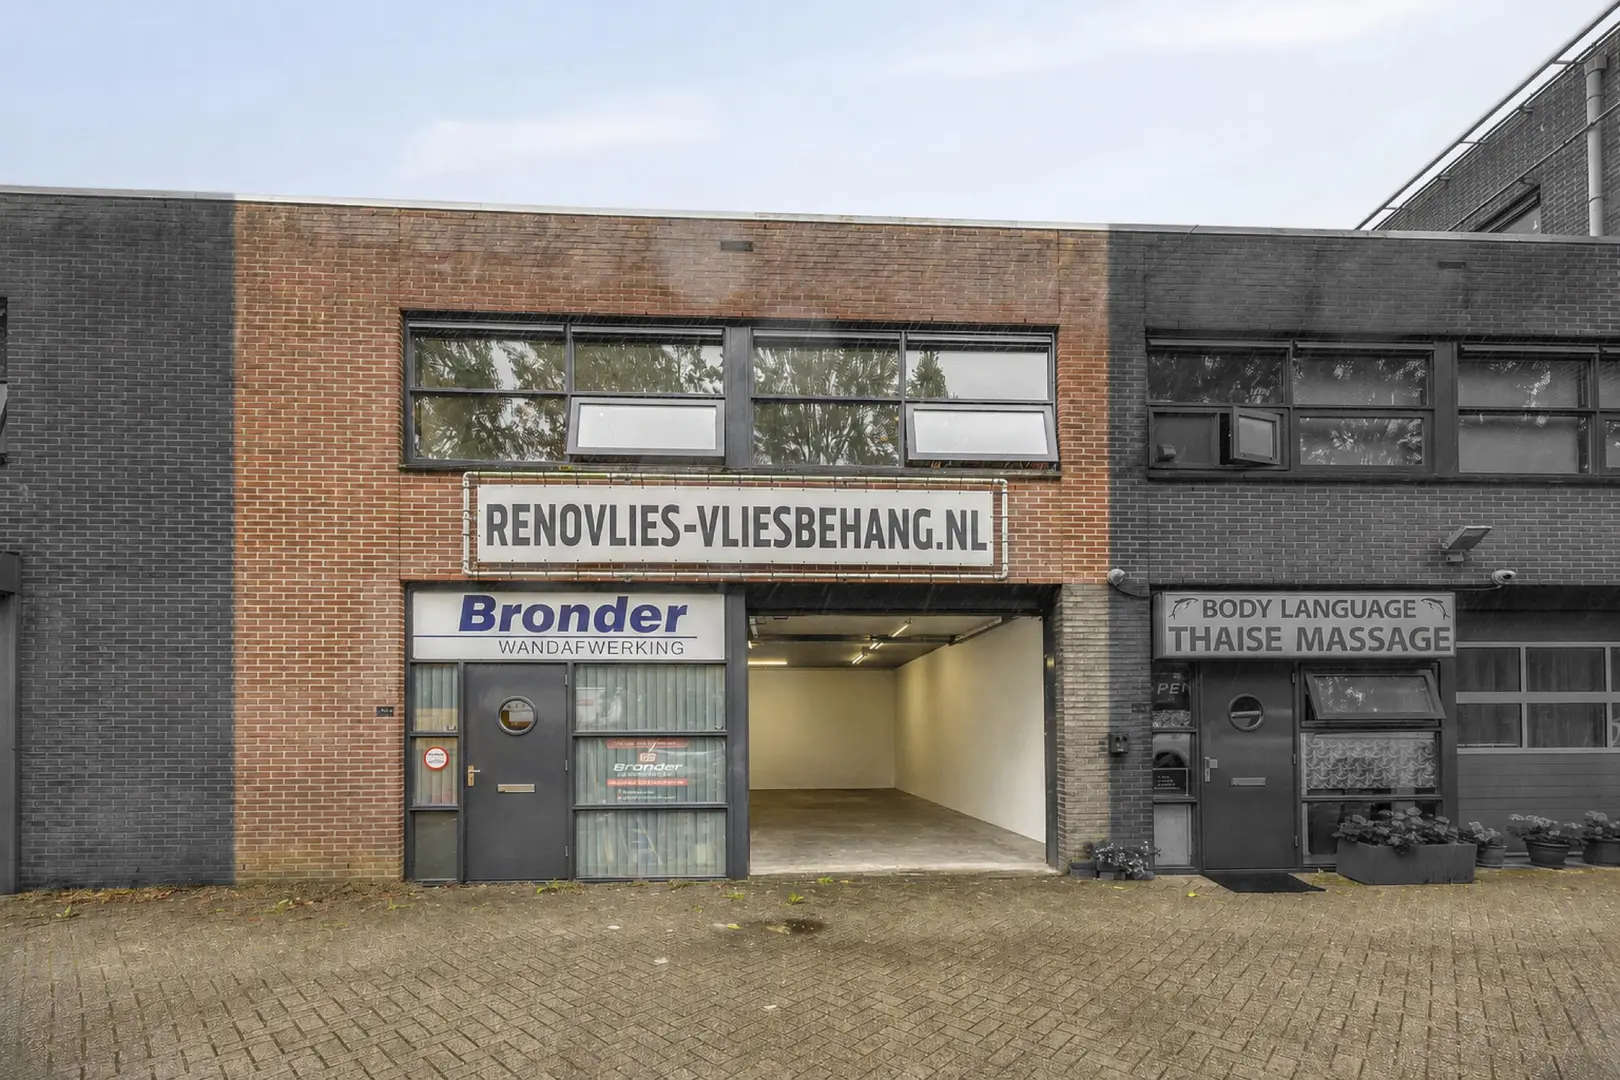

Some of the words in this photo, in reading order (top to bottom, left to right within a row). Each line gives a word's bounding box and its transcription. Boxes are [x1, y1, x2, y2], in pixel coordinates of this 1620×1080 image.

[485, 502, 988, 552] RENOVLIES-VLIESBEHANG.NL
[458, 594, 688, 633] Bronder
[1202, 599, 1272, 619] BODY
[1281, 599, 1416, 619] LANGUAGE
[498, 639, 685, 656] WANDAFWERKING
[1168, 626, 1282, 652] THAISE
[1296, 626, 1451, 653] MASSAGE
[1151, 682, 1191, 694] PEN
[613, 763, 683, 771] Bronder
